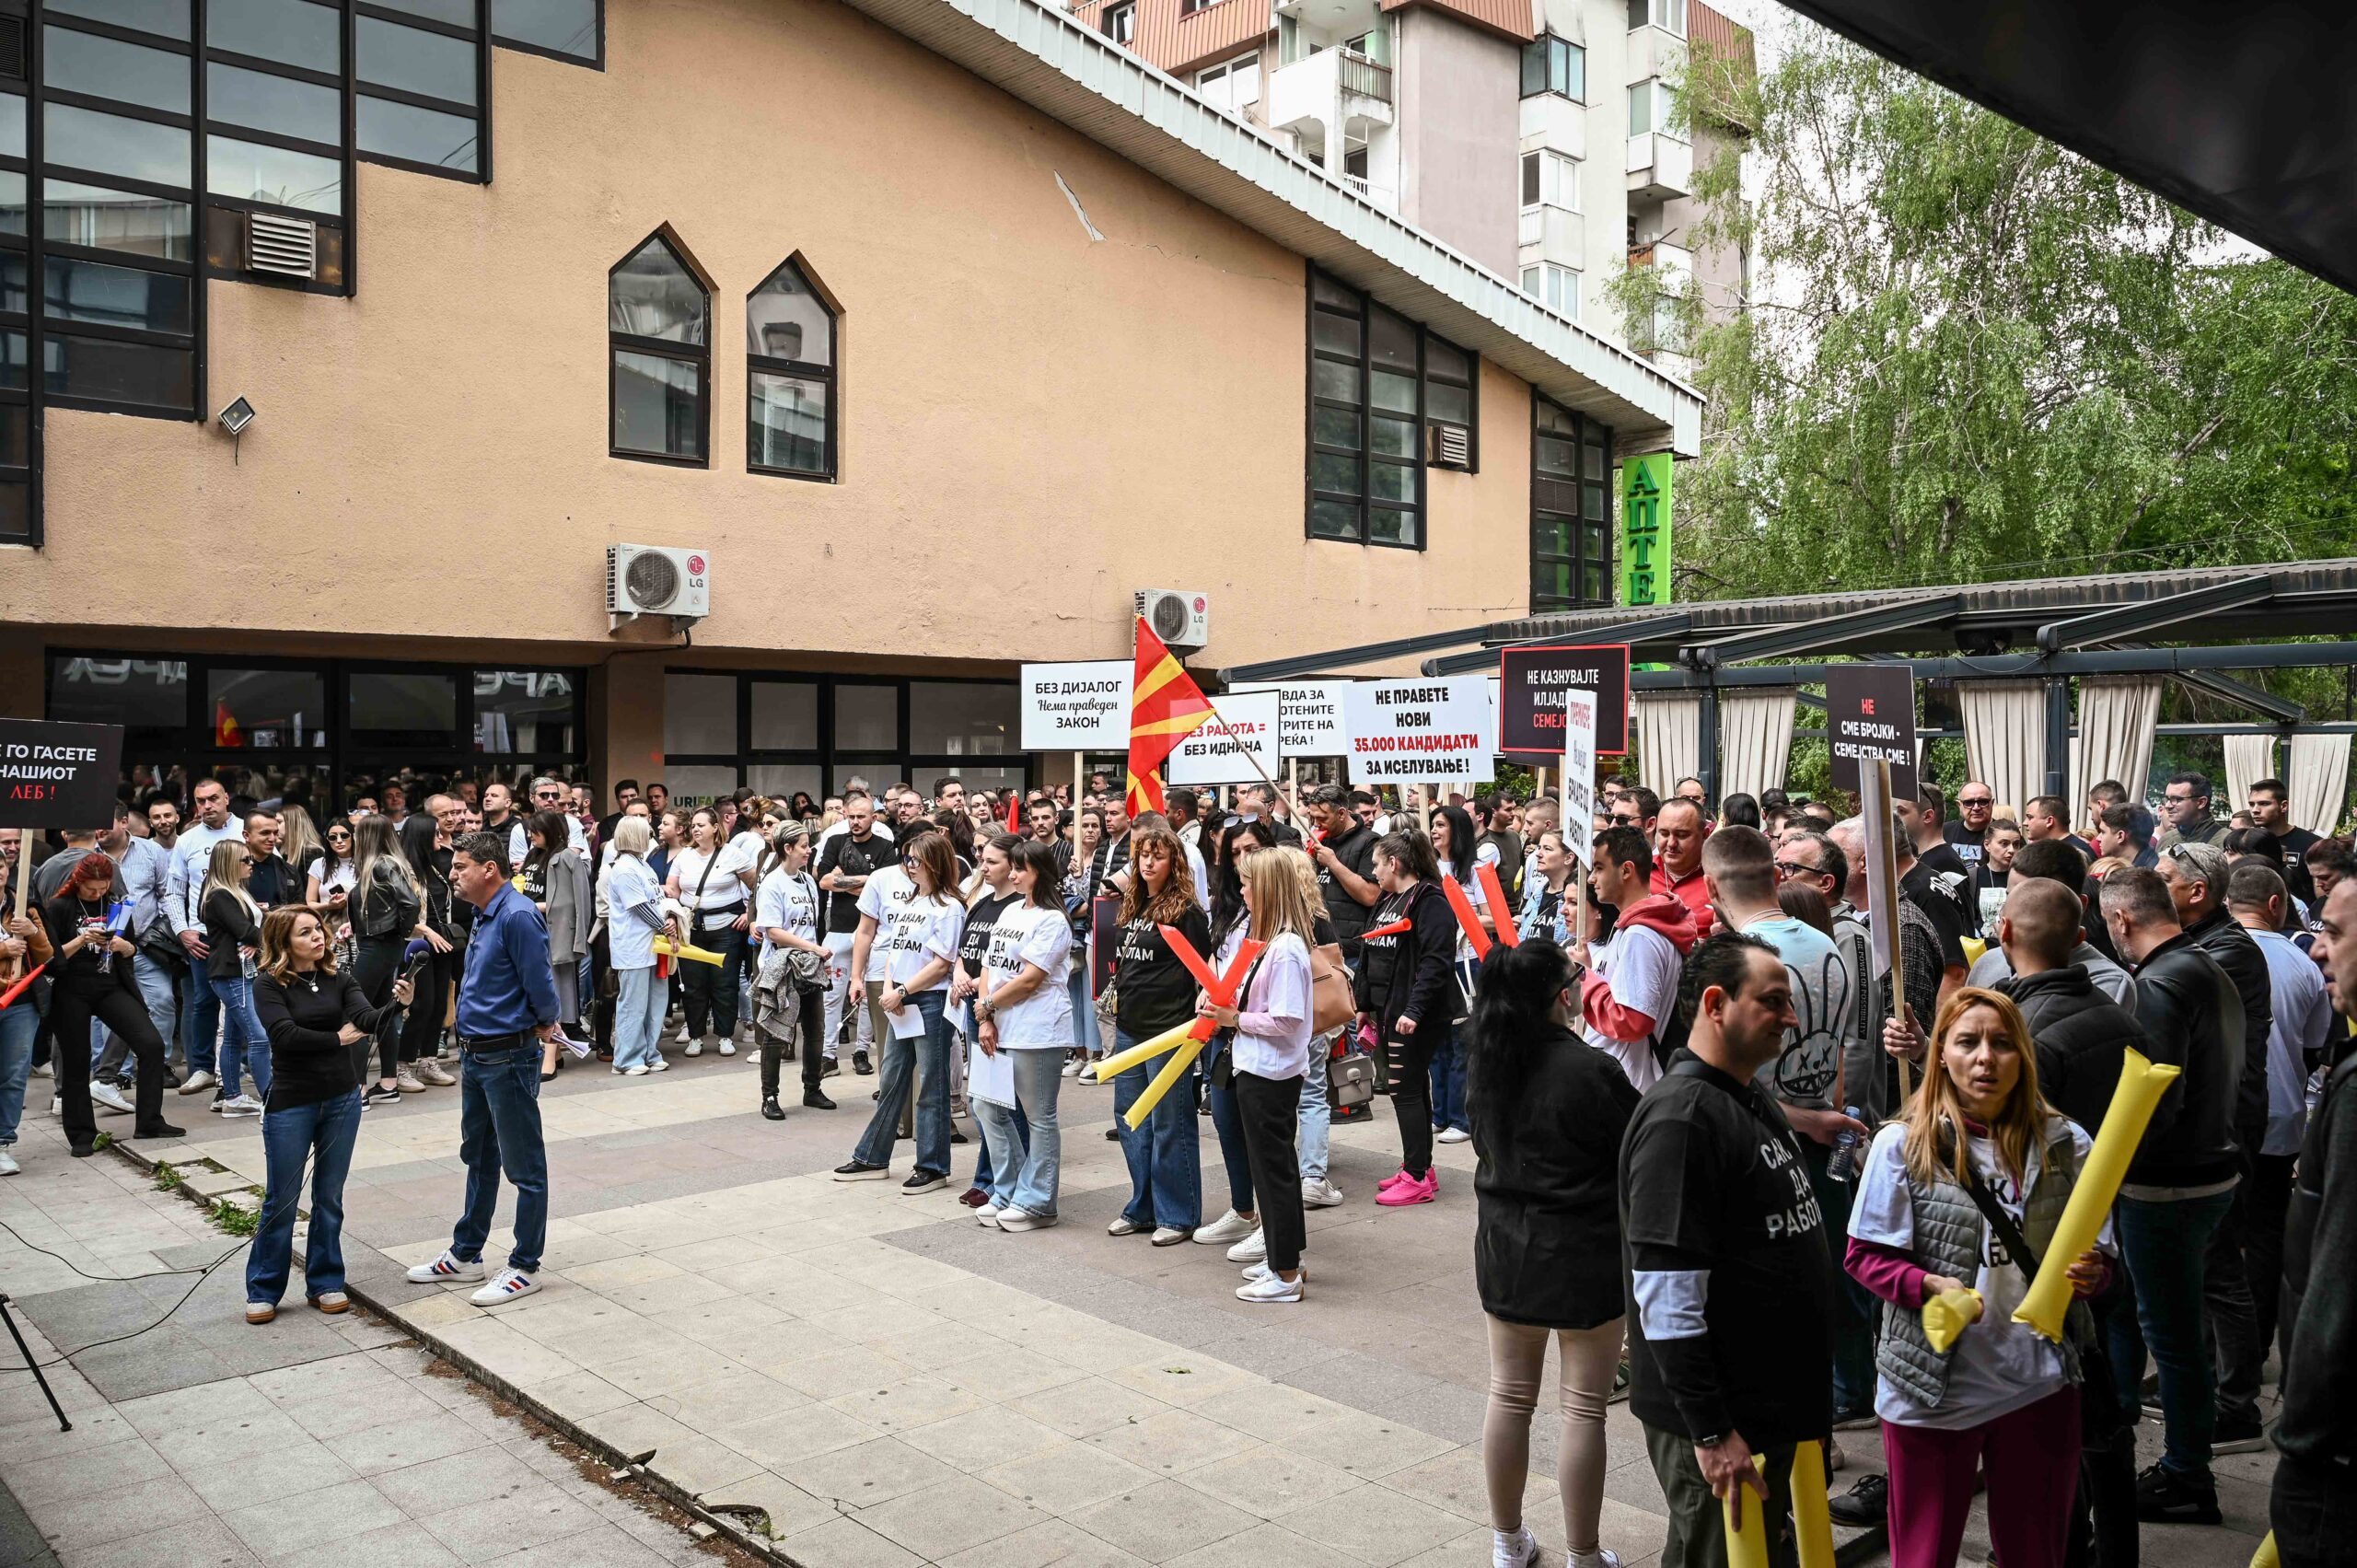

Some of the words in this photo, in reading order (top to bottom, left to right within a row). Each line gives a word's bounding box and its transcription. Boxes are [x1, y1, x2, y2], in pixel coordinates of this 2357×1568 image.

[1628, 460, 1660, 606] АПТЕ
[689, 578, 703, 588] LG
[1193, 615, 1204, 624] LG
[1527, 670, 1538, 684] НЕ
[1540, 668, 1599, 684] КАЗНУВАЈТЕ
[1035, 682, 1059, 694] БЕЗ
[1061, 680, 1122, 695] ДИЈАЛОГ
[1282, 690, 1306, 702] ВДА
[1309, 690, 1325, 700] ЗА
[1376, 691, 1391, 705] НЕ
[1394, 687, 1449, 704] ПРАВЕТЕ
[1534, 691, 1567, 709] ИЛЈАД
[1038, 699, 1066, 712] Нема
[1068, 697, 1118, 715] праведен
[1281, 704, 1334, 715] ОТЕНИТЕ
[1861, 698, 1875, 714] НЕ
[1056, 716, 1099, 728] ЗАКОН
[1282, 720, 1315, 730] РИТЕ
[1318, 719, 1334, 730] НА
[1396, 712, 1432, 727] НОВИ
[1533, 714, 1567, 728] СЕМЕЈС
[1207, 722, 1255, 737] РАБОТА
[1841, 720, 1859, 736] СМЕ
[1861, 722, 1895, 740] БРОЈКИ
[1184, 744, 1206, 756] БЕЗ
[1354, 737, 1395, 752] 35.000
[1398, 734, 1479, 752] КАНДИДАТИ
[6, 744, 29, 759] ГО
[33, 745, 97, 761] ГАСЕТЕ
[1834, 742, 1884, 760] СЕМЕЈСТВА
[1886, 749, 1905, 765] СМЕ
[1366, 760, 1383, 775] ЗА
[1385, 758, 1464, 774] ИСЕЛУВАЊЕ
[10, 784, 44, 799] ЛЕБ
[673, 795, 714, 807] URIFA
[900, 913, 926, 924] АКАМ
[994, 940, 1005, 954] ДА
[1859, 950, 1867, 976] POWER
[1860, 979, 1867, 990] OF
[1789, 1166, 1811, 1201] ДА
